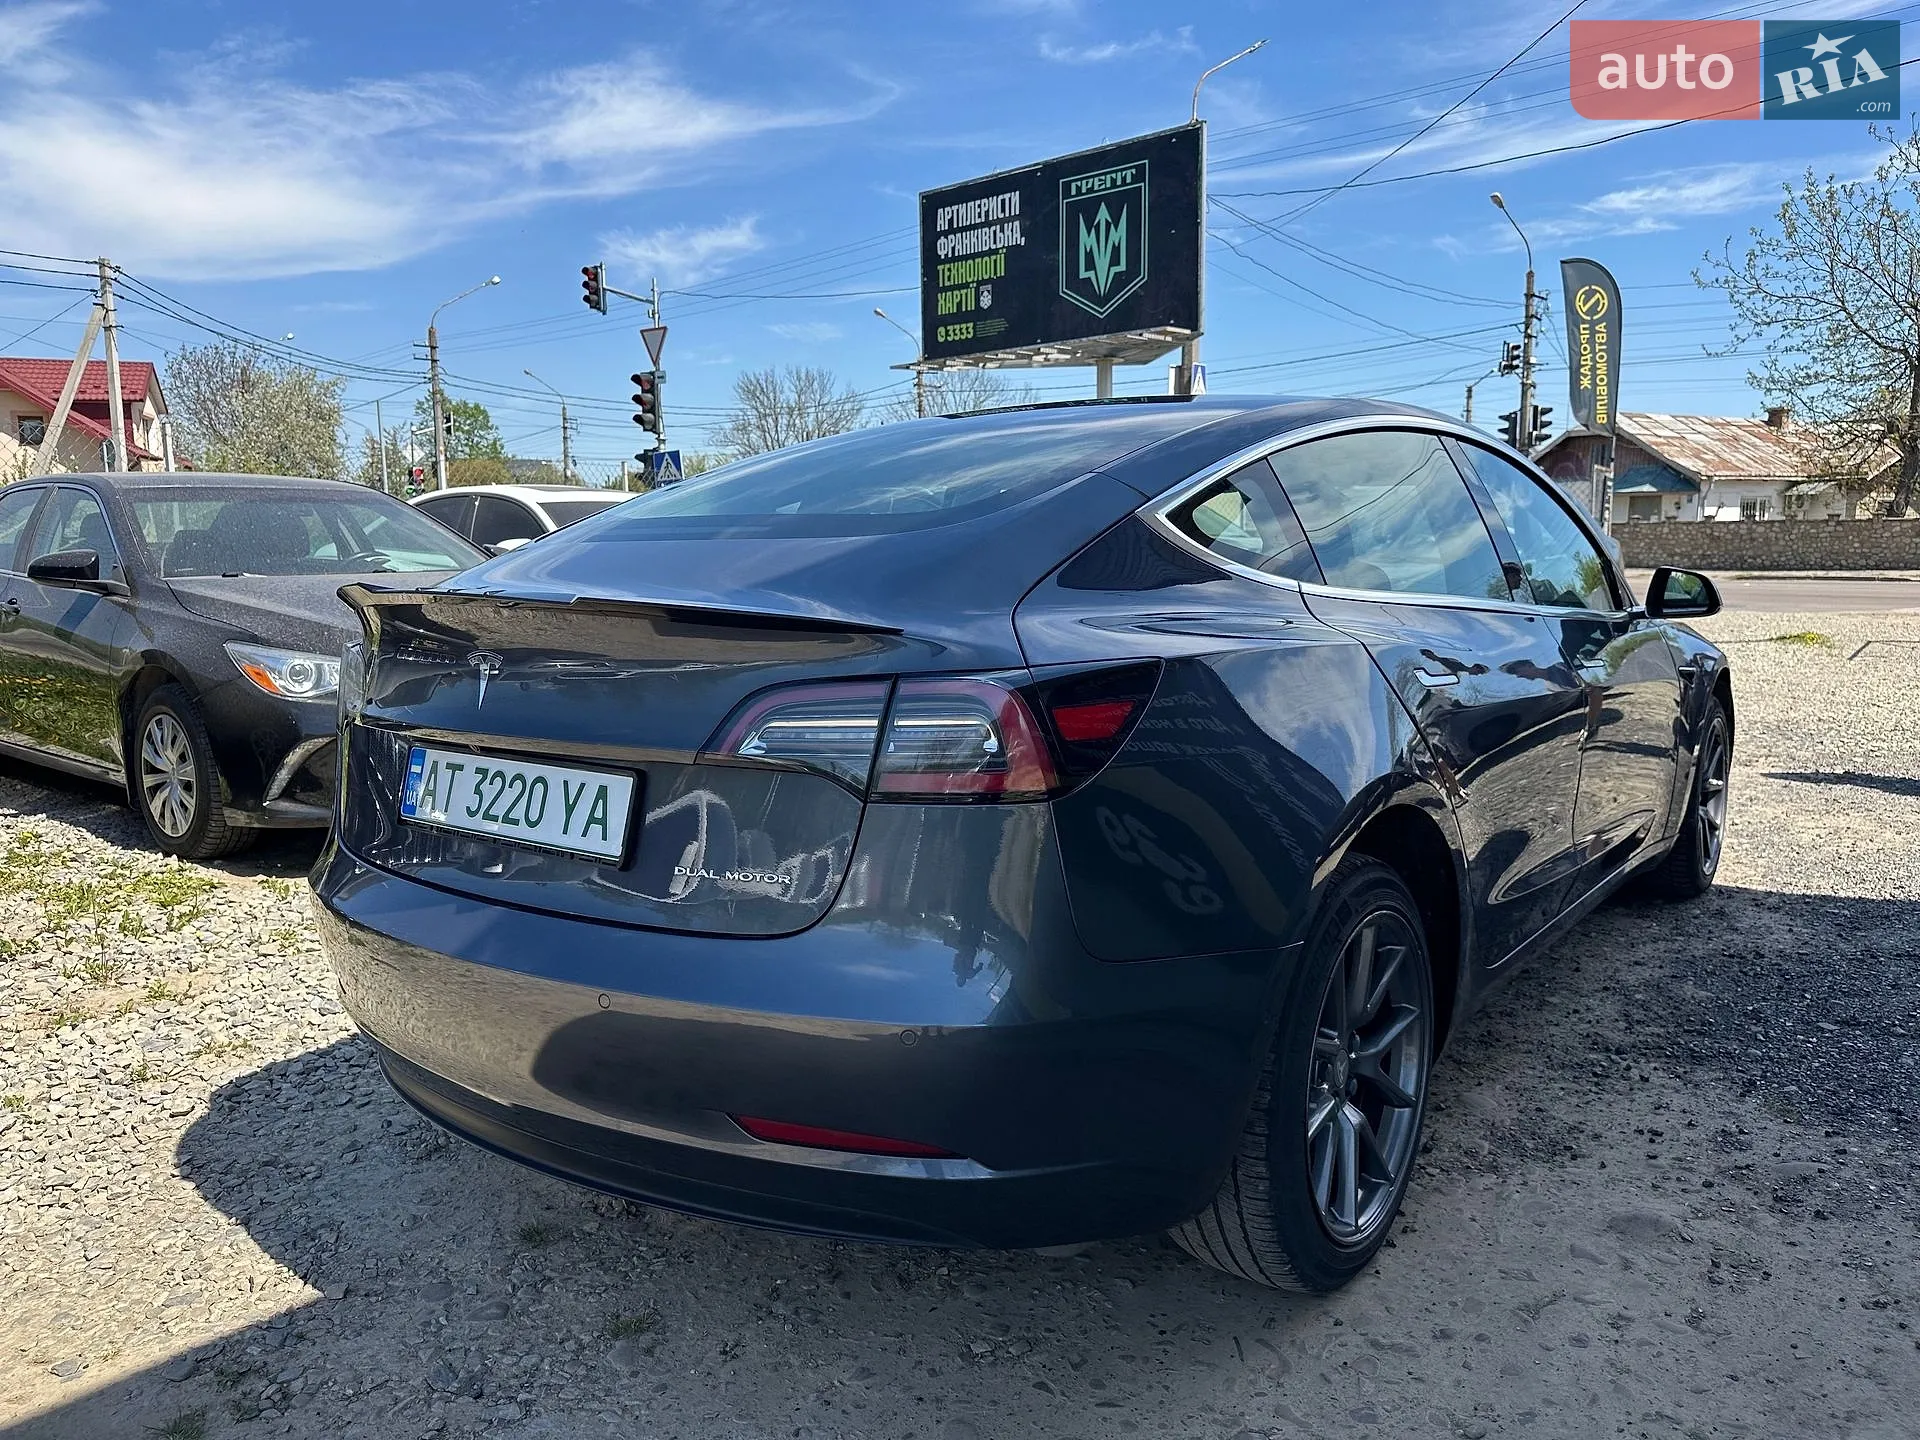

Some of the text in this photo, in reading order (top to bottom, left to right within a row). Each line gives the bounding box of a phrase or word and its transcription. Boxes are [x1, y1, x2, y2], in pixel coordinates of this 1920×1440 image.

[936, 190, 1020, 232] АРТИЛЕРИСТИ
[936, 220, 1025, 259] ФРАНКІВСЬКА,
[937, 248, 1006, 287] ТЕХНОЛОГІЇ
[937, 283, 976, 315] ХАРТІЇ
[947, 322, 974, 342] 3333
[419, 760, 608, 842] AT 3220 YA
[674, 866, 791, 884] DUAL MOTOR
